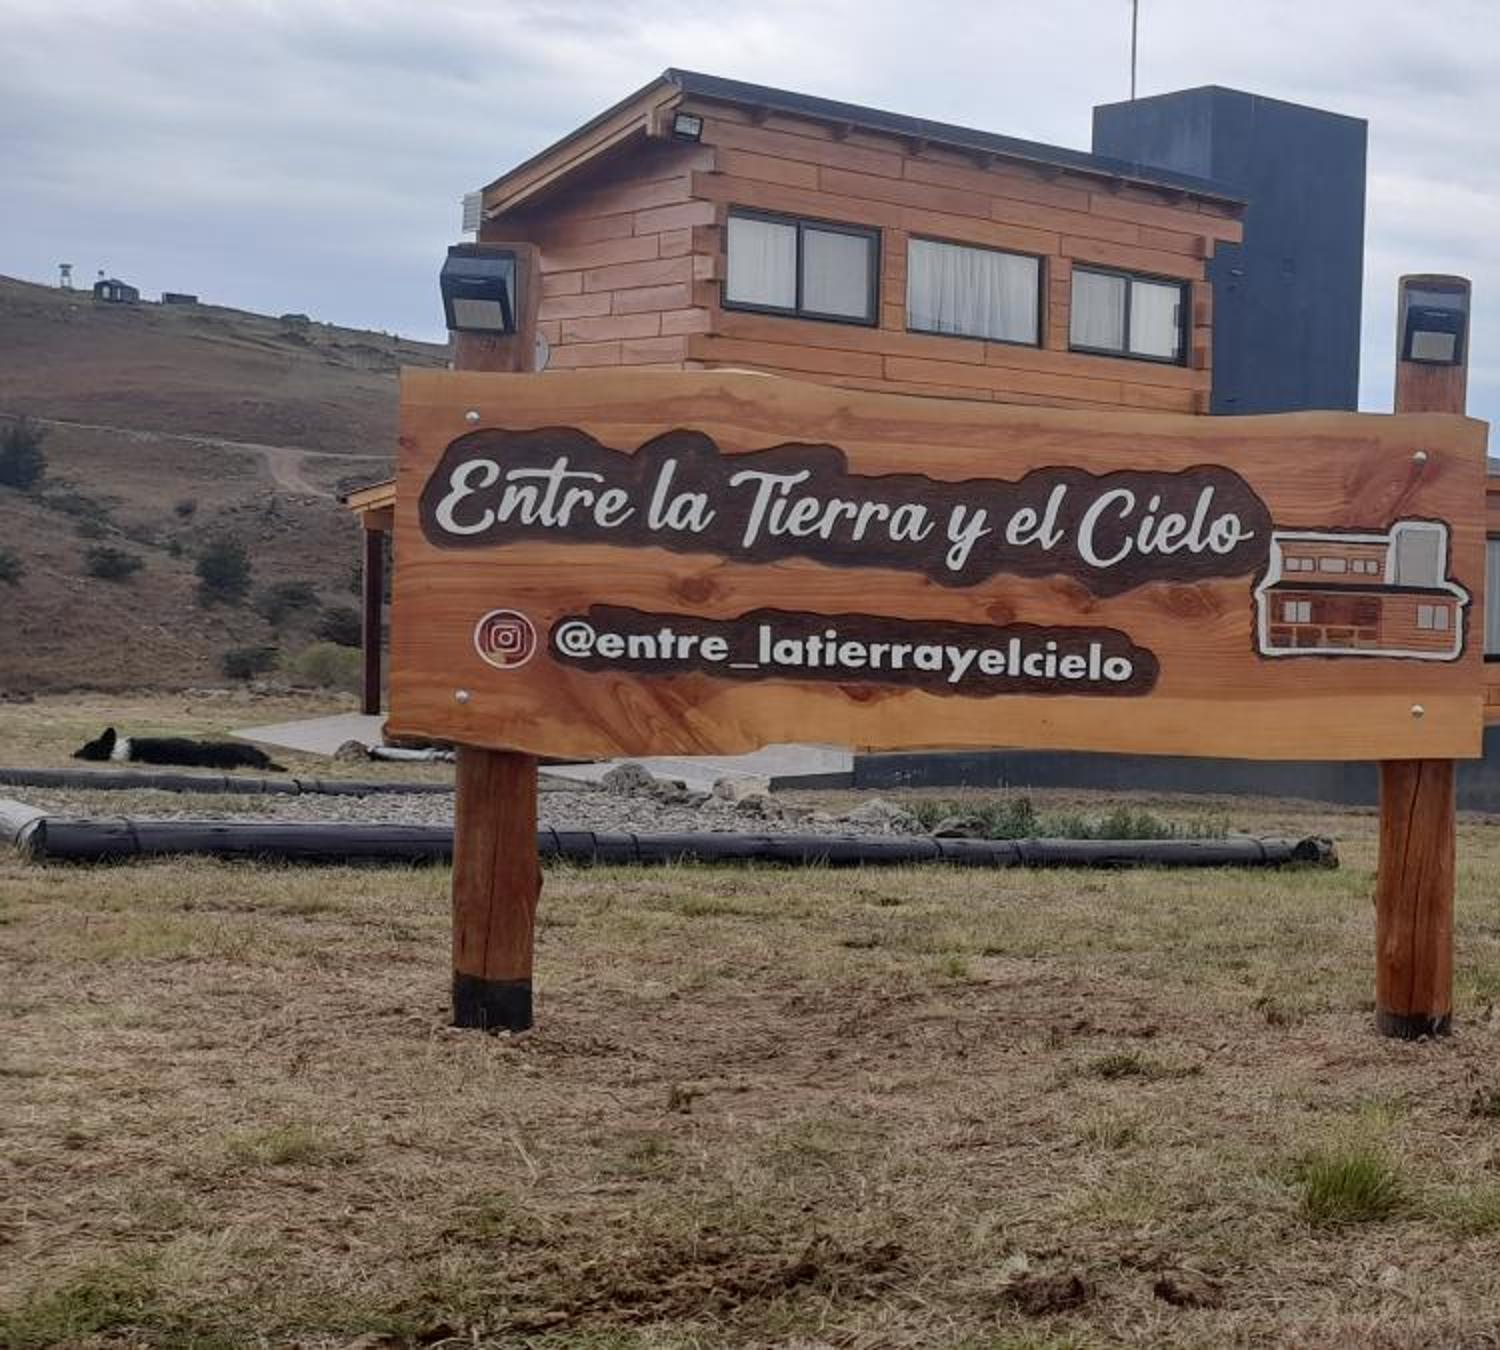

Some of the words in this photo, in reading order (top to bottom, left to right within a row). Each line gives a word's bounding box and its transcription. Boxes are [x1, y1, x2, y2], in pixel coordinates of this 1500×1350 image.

[434, 457, 636, 536] Entre
[646, 458, 717, 534] la
[729, 468, 936, 549] Tierra
[944, 504, 993, 572] y
[1004, 483, 1068, 551] el
[1076, 486, 1257, 569] Cielo
[554, 620, 1134, 684] @entre_latierrayelcielo
